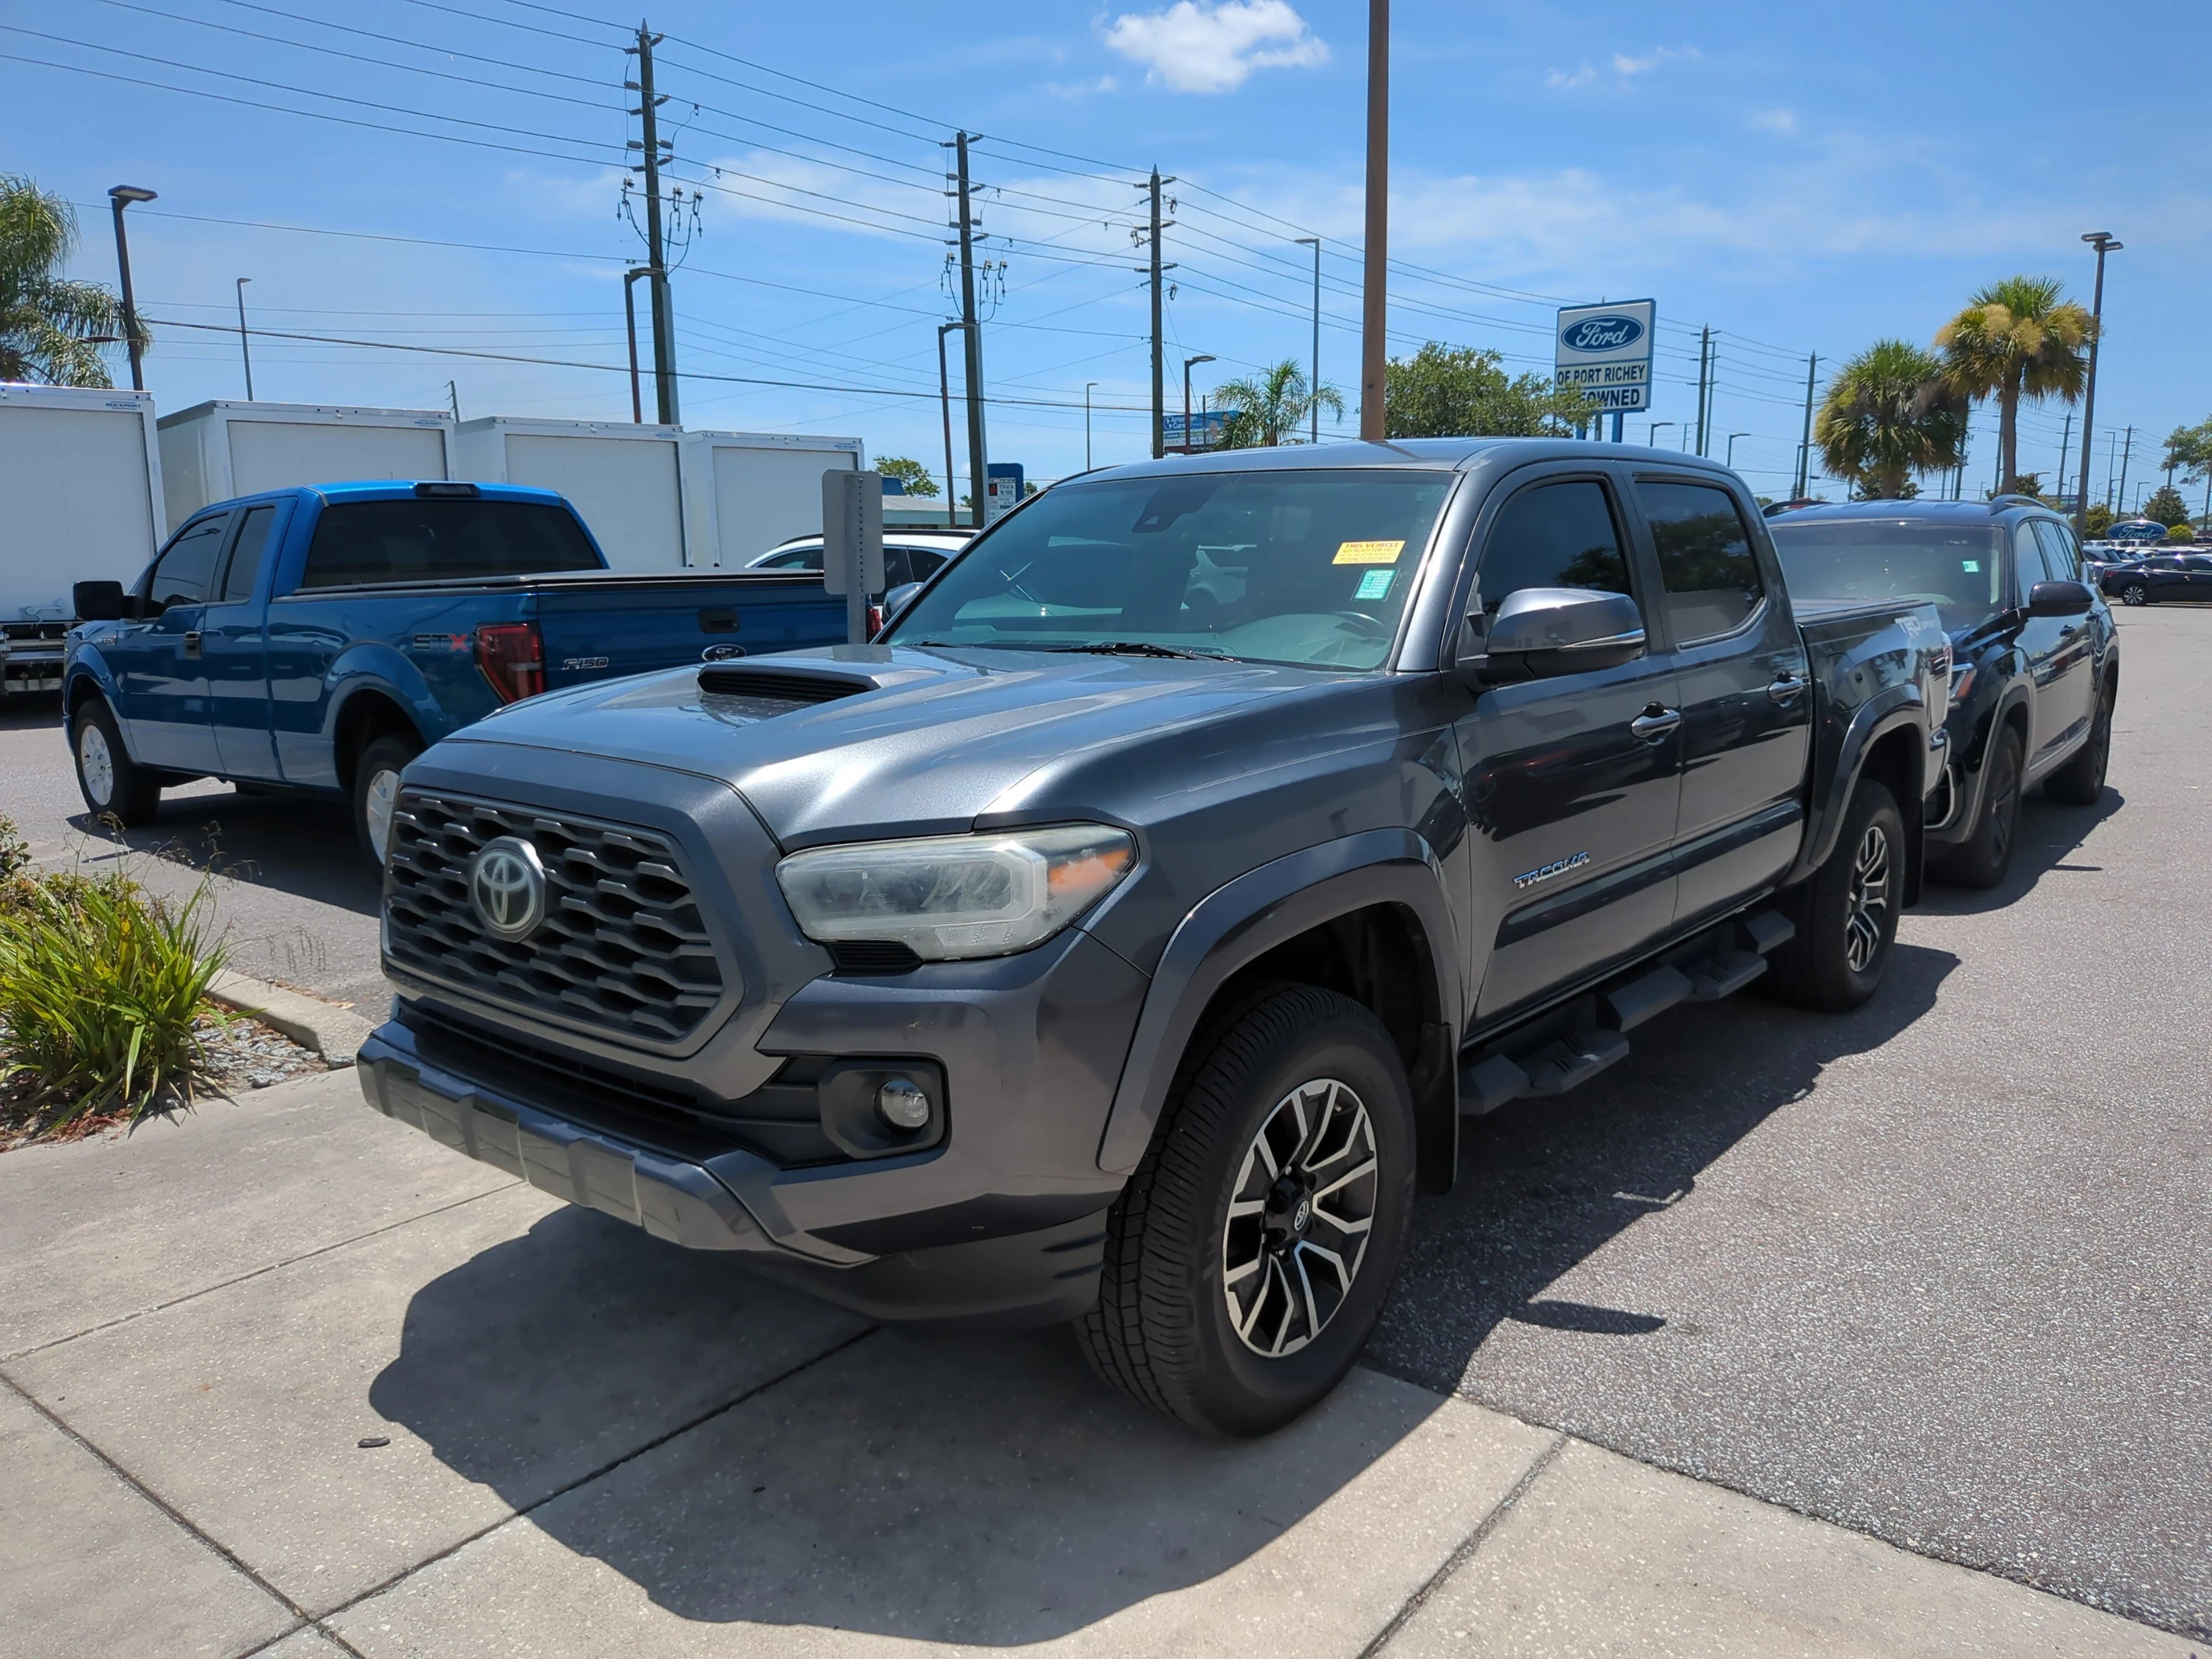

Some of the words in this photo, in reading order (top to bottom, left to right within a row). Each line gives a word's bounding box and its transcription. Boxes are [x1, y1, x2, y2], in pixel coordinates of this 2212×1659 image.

[1576, 320, 1629, 347] Ford
[1557, 371, 1571, 385] OF
[1574, 368, 1601, 383] PORT
[1604, 364, 1645, 382] RICHEY
[2119, 526, 2158, 539] Ford
[414, 634, 469, 652] STX
[1514, 851, 1590, 889] TACOMA
